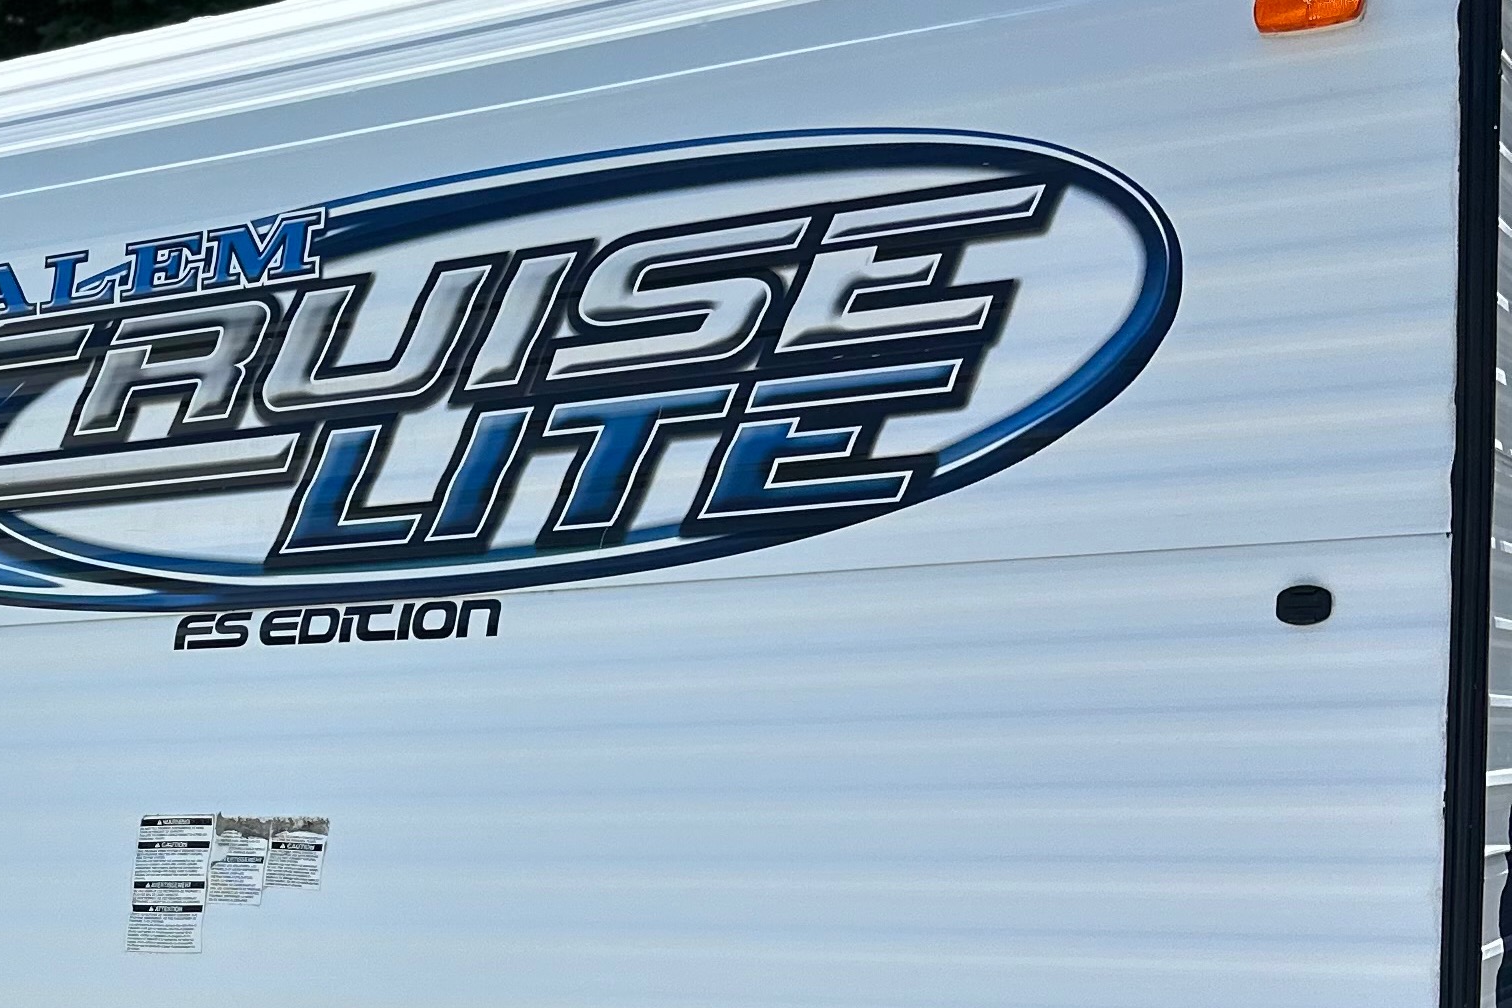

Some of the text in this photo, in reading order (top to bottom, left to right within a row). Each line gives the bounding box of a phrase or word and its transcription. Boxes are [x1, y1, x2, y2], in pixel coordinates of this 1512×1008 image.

[273, 355, 968, 562] LITE
[174, 598, 502, 650] FS EDITION
[286, 843, 315, 851] CAUTION
